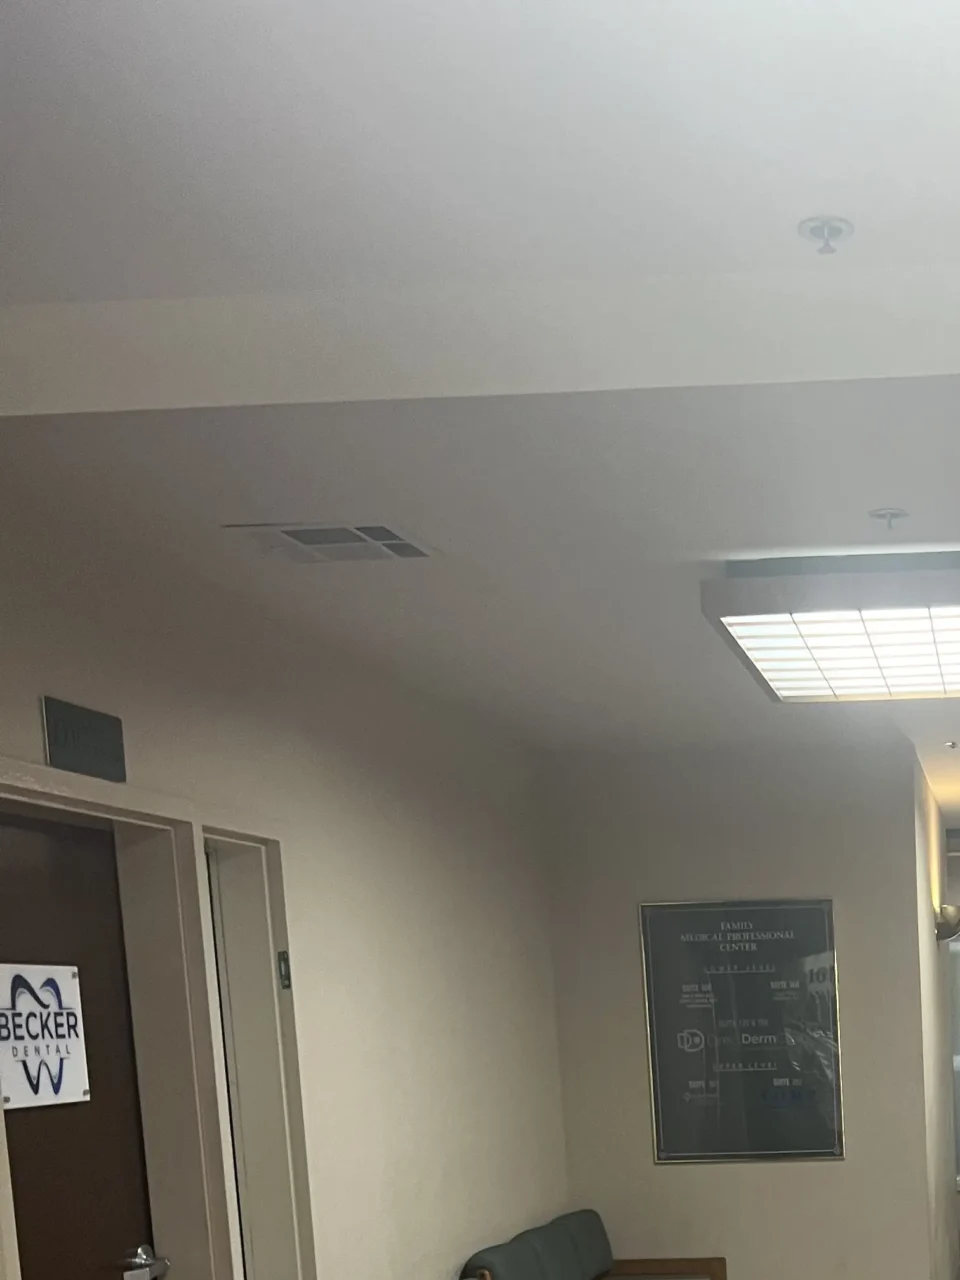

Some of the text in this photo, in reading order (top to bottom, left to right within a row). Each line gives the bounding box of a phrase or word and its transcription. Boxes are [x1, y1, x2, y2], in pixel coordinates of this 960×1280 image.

[720, 921, 753, 931] FAMILY
[680, 930, 796, 942] MEDICAL PROFESSIONAL
[719, 943, 757, 952] CENTER
[0, 1011, 79, 1041] BECKER
[12, 1044, 71, 1057] DENTAL
